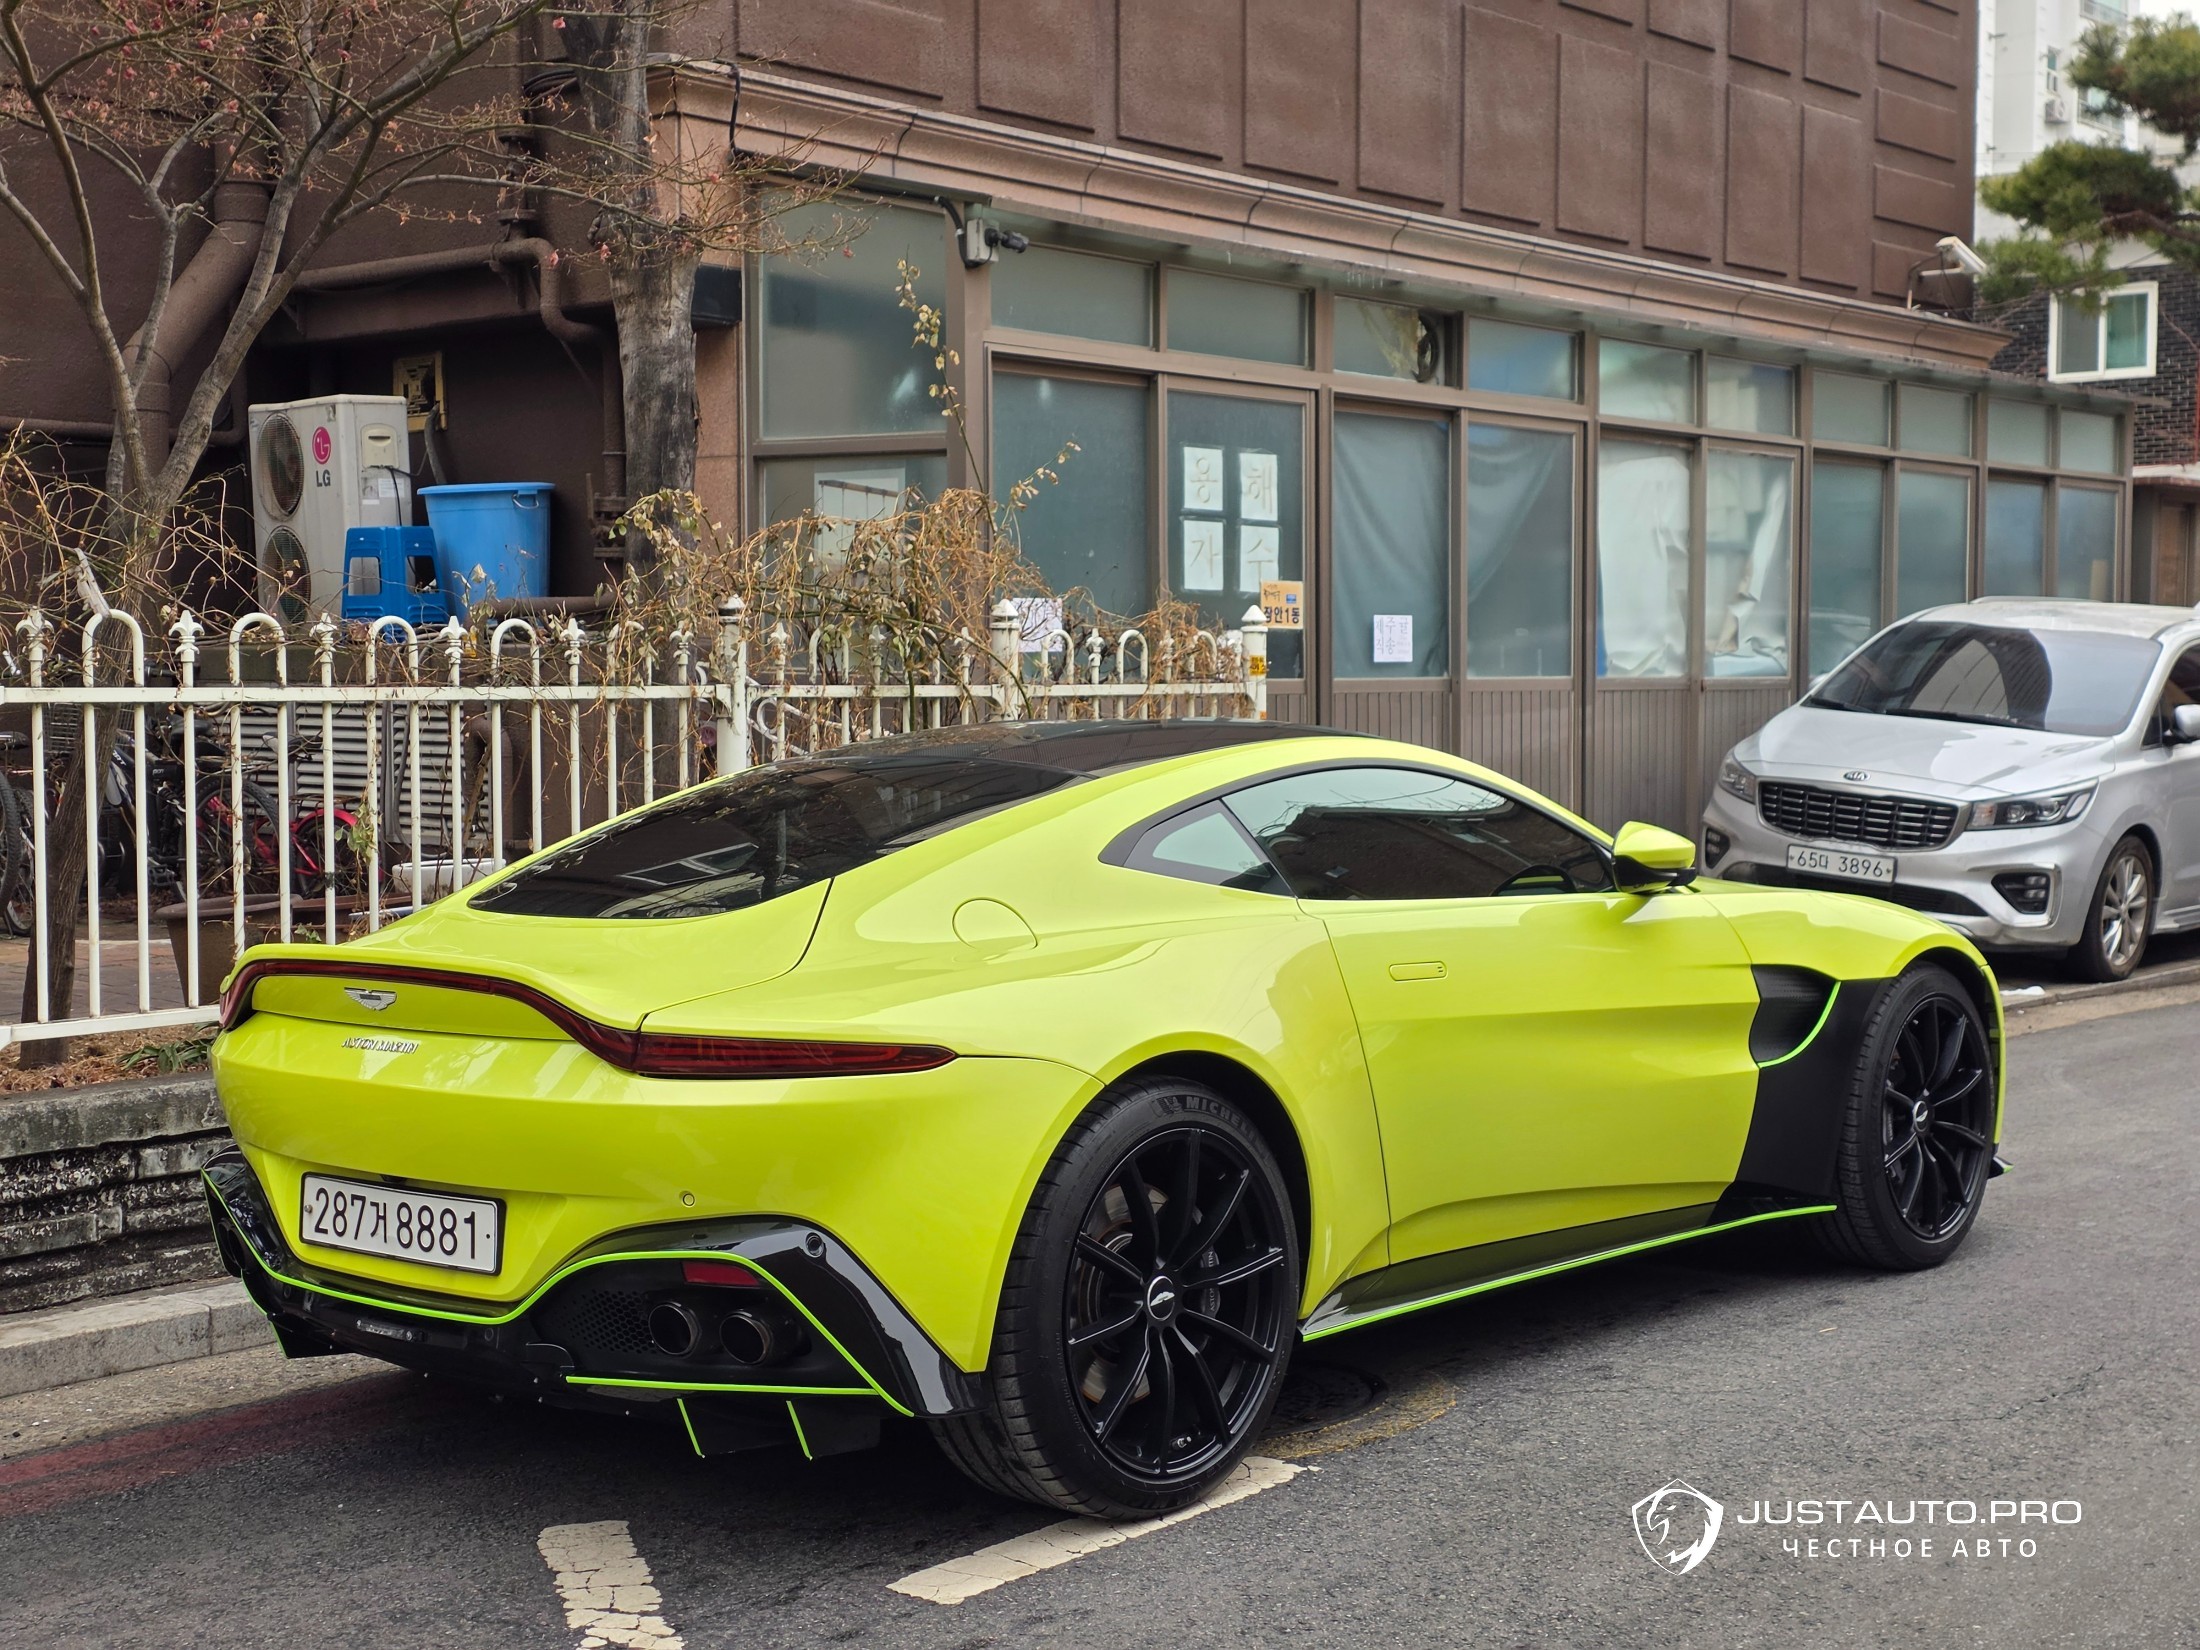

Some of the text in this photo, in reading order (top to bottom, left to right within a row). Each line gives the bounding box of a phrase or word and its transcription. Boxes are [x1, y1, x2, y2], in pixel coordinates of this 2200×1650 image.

[316, 469, 331, 487] LG
[1838, 856, 1883, 878] 3896
[341, 1037, 419, 1054] ASTON MARTIN
